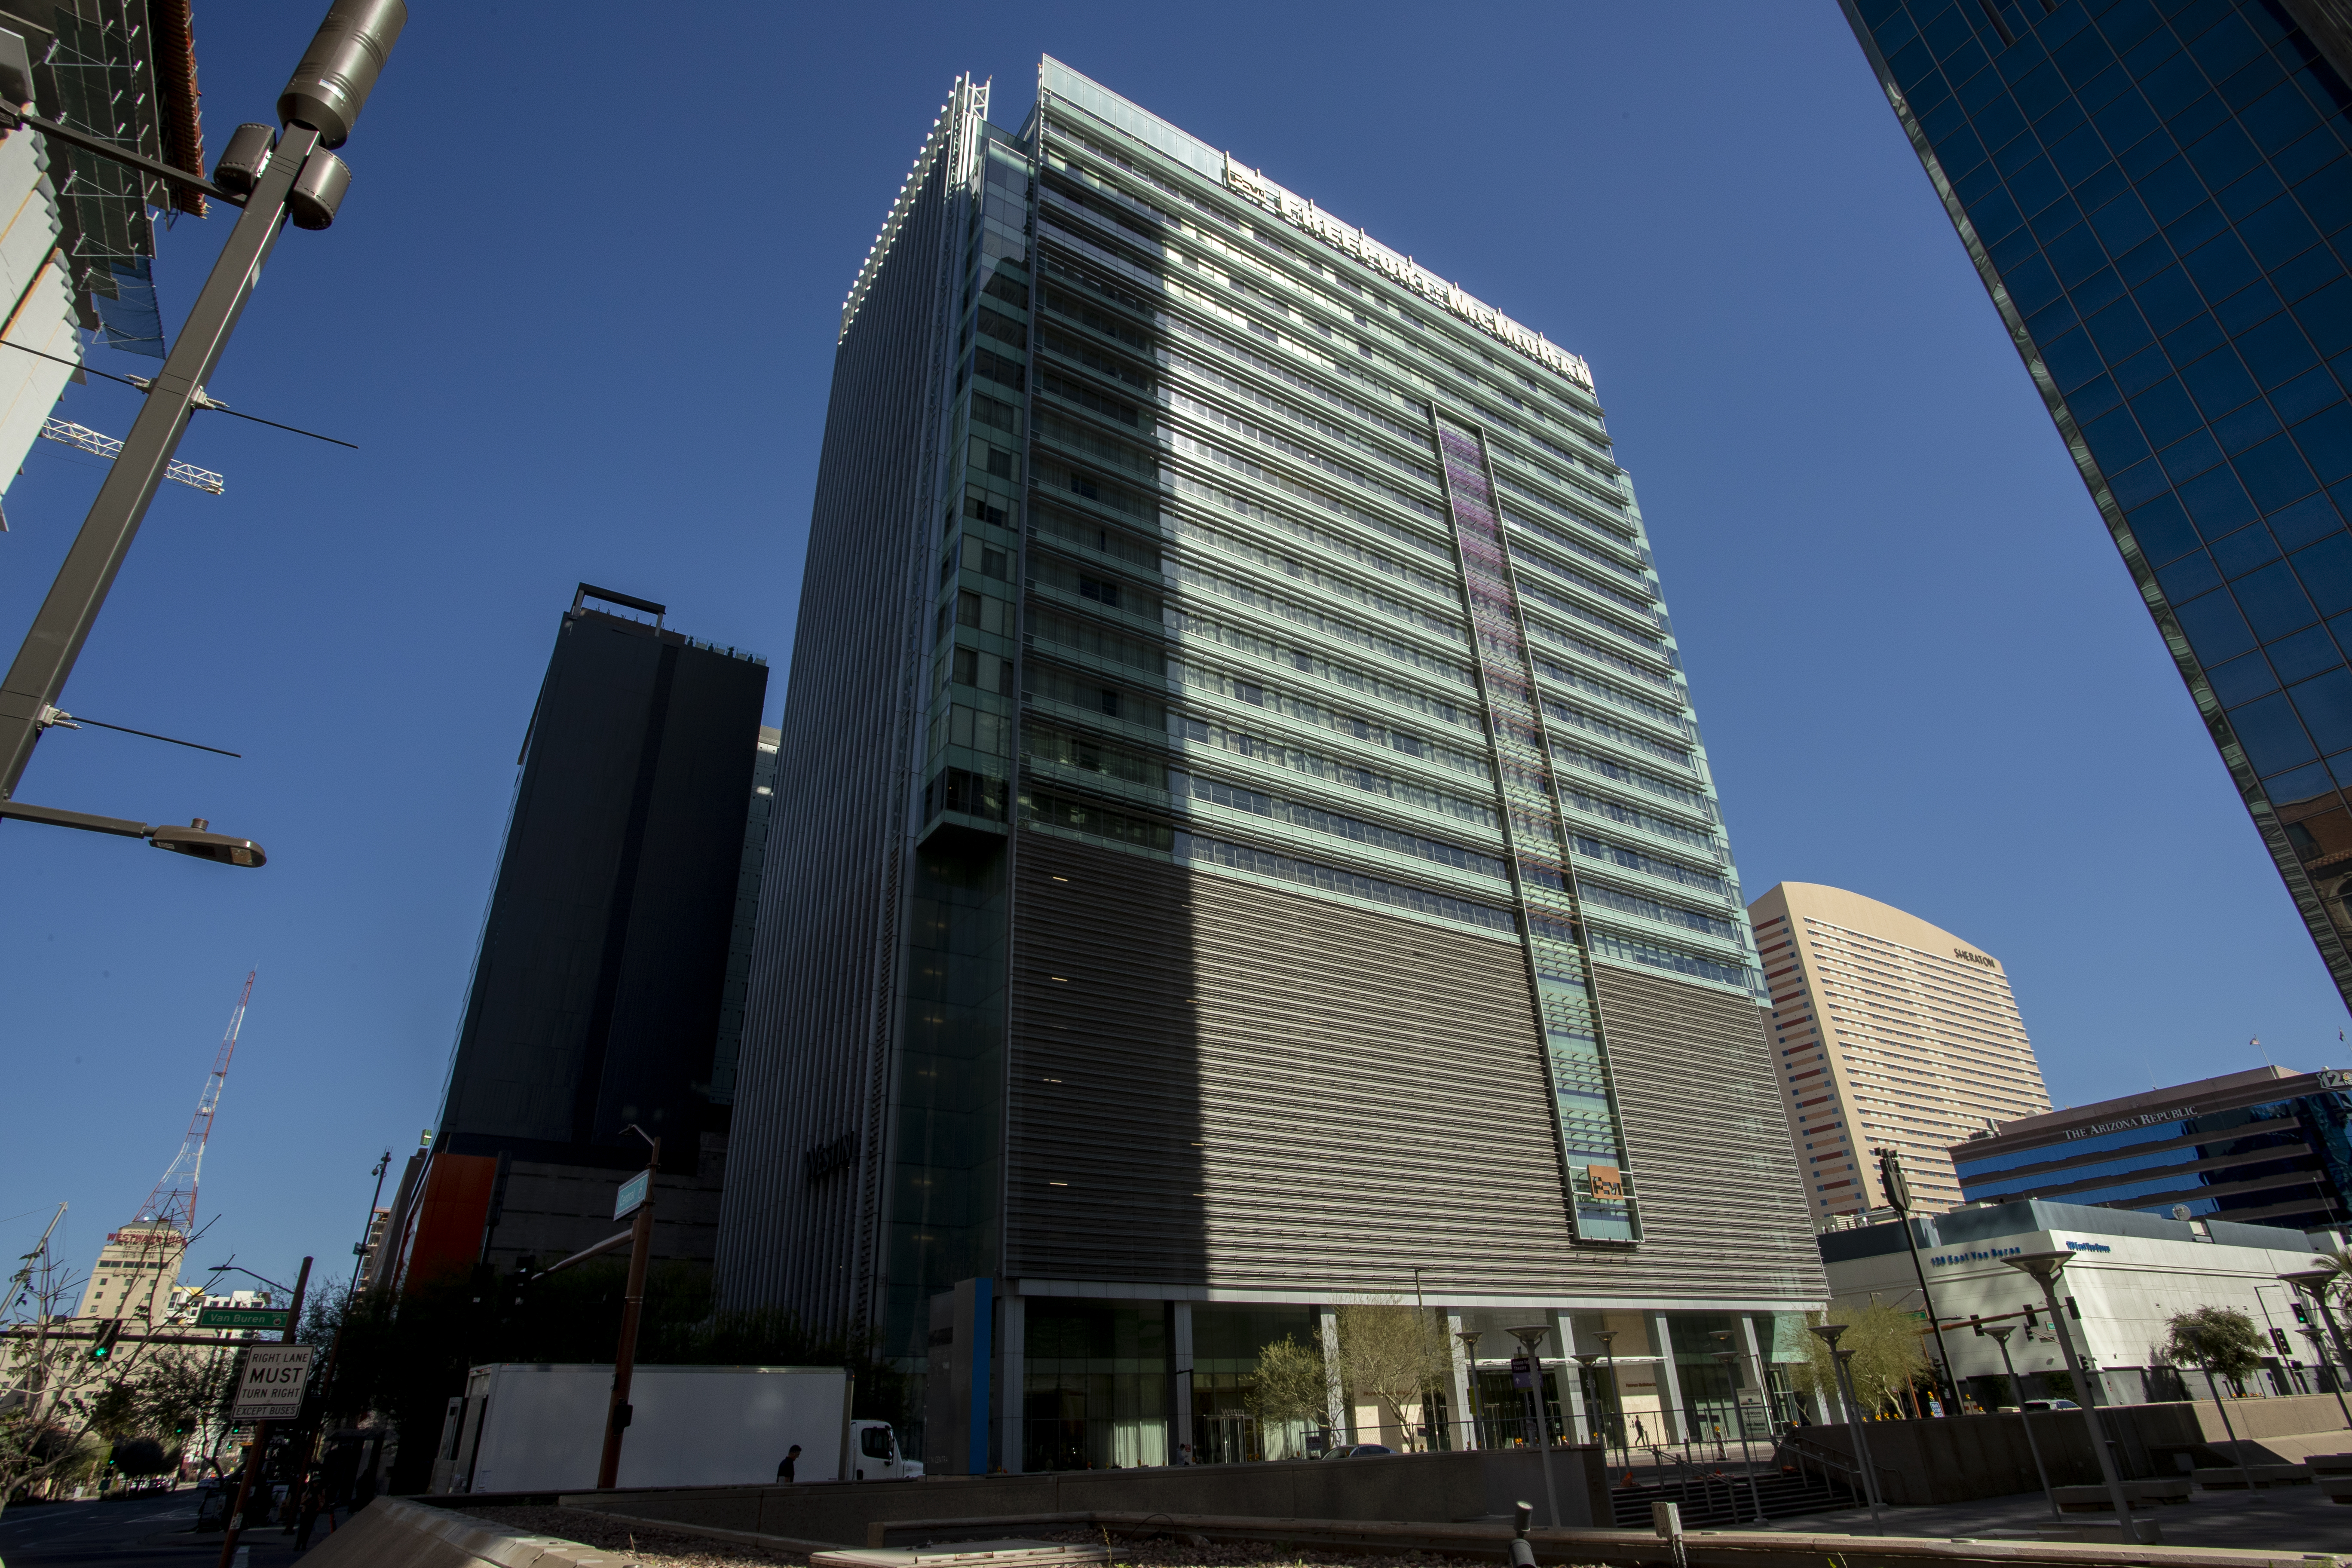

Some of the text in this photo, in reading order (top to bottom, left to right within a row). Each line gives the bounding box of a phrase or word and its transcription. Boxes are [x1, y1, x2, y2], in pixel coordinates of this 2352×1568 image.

[1954, 948, 1995, 968] SHERATON
[2321, 1071, 2345, 1087] 12
[2063, 1106, 2198, 1139] THE ARIZONA REPUBLIC
[620, 1188, 636, 1207] Central
[1947, 1253, 1969, 1265] East
[1970, 1251, 1989, 1260] Van
[1990, 1246, 2021, 1257] Buren
[211, 1314, 230, 1322] Van
[233, 1314, 265, 1323] Buren
[252, 1354, 309, 1363] RIGHT LANE
[249, 1367, 303, 1383] MUST
[242, 1388, 300, 1398] TURN RIGHT
[236, 1406, 296, 1415] EXCEPT BUSES
